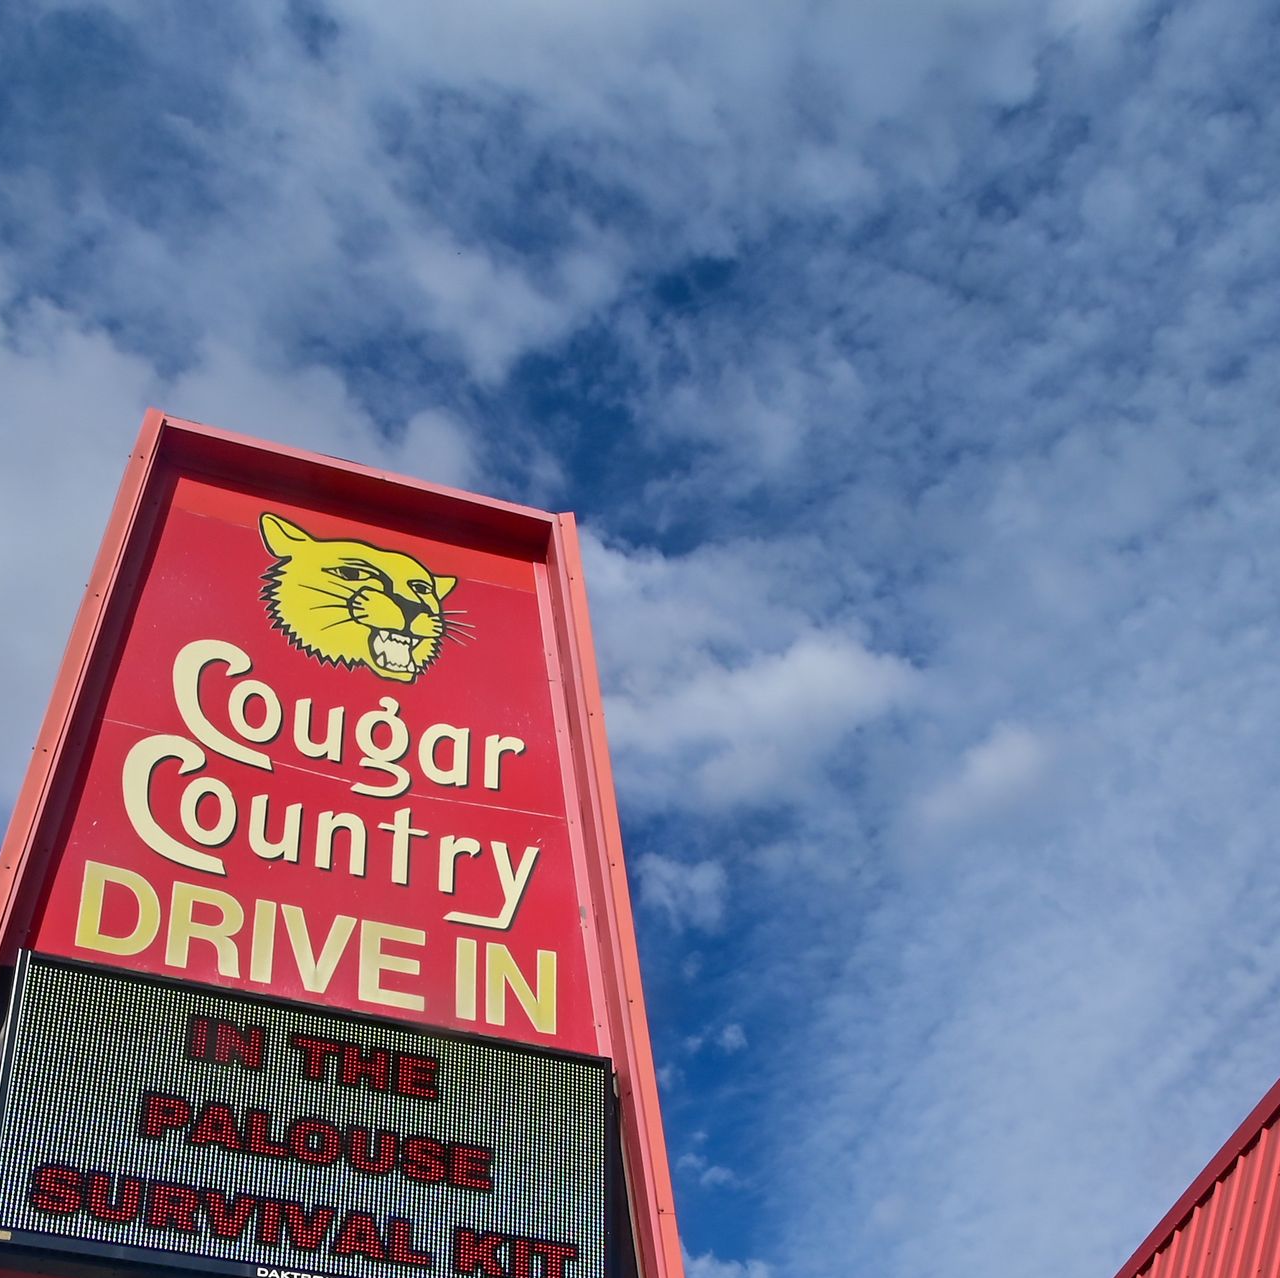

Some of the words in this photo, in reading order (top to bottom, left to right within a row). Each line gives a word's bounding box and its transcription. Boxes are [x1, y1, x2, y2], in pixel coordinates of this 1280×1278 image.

[172, 639, 525, 797] Cougar
[122, 734, 540, 929] Country
[74, 859, 426, 1012] DRIVE
[455, 937, 557, 1035] IN
[189, 1017, 265, 1072] IN
[292, 1034, 441, 1100] THE
[140, 1092, 494, 1192] PALOUSE
[29, 1164, 431, 1267] SURVIVAL
